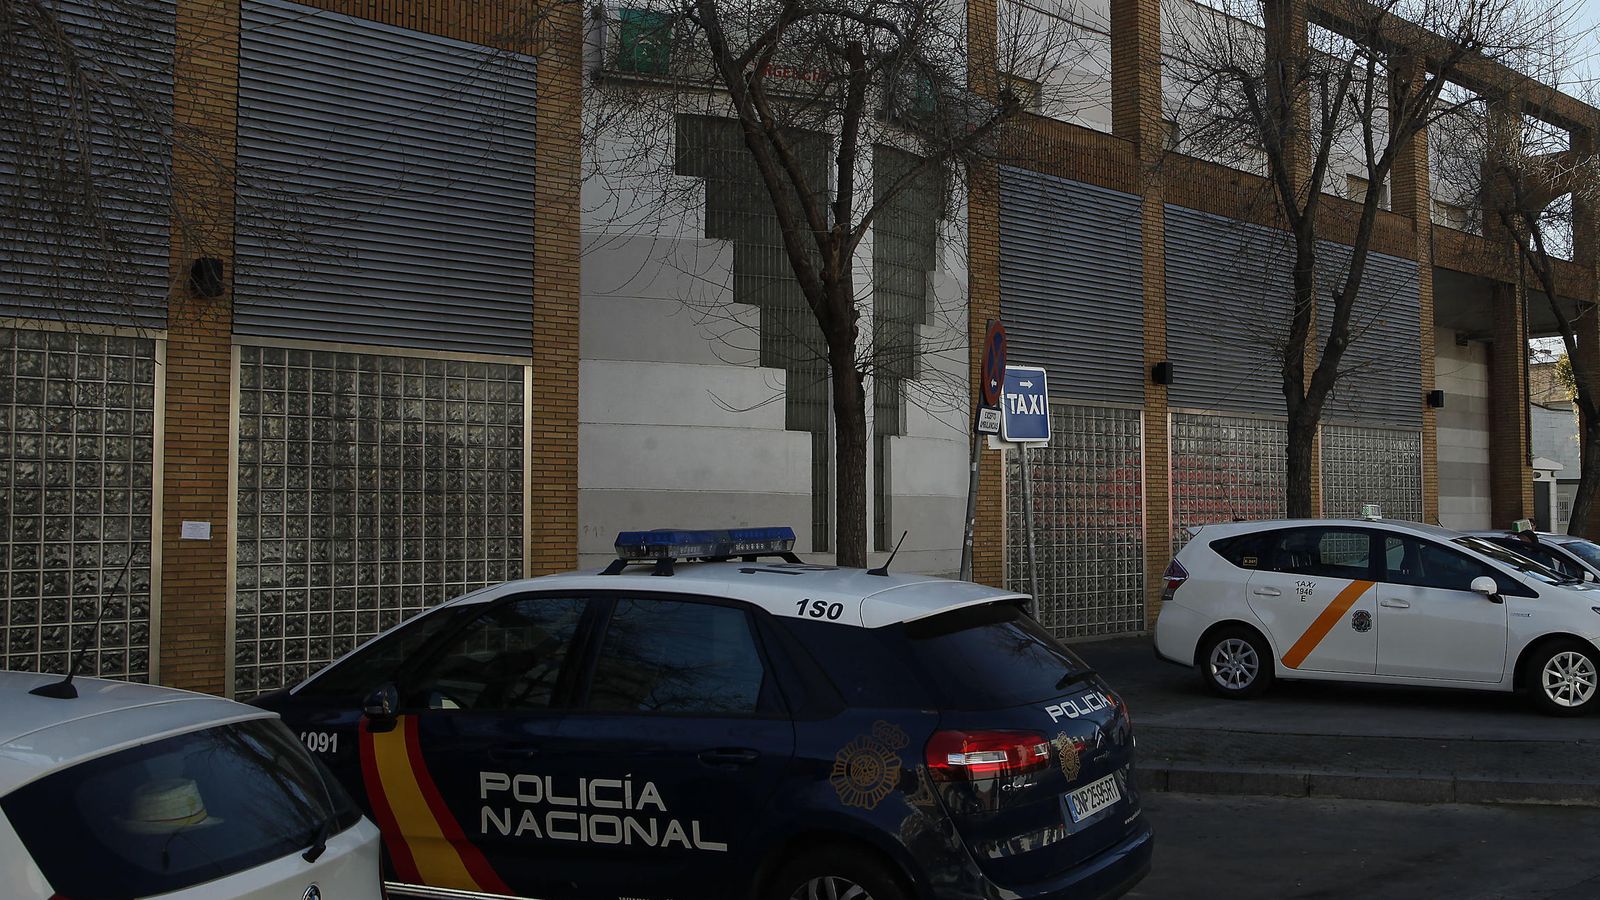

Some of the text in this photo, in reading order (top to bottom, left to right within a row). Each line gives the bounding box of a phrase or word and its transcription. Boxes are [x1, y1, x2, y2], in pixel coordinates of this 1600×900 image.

[1006, 393, 1045, 415] TAXI
[1295, 580, 1317, 588] TAXI
[1296, 587, 1313, 596] 1946
[307, 731, 338, 753] 091
[479, 771, 668, 812] POLICÍA
[480, 805, 728, 852] NACIONAL
